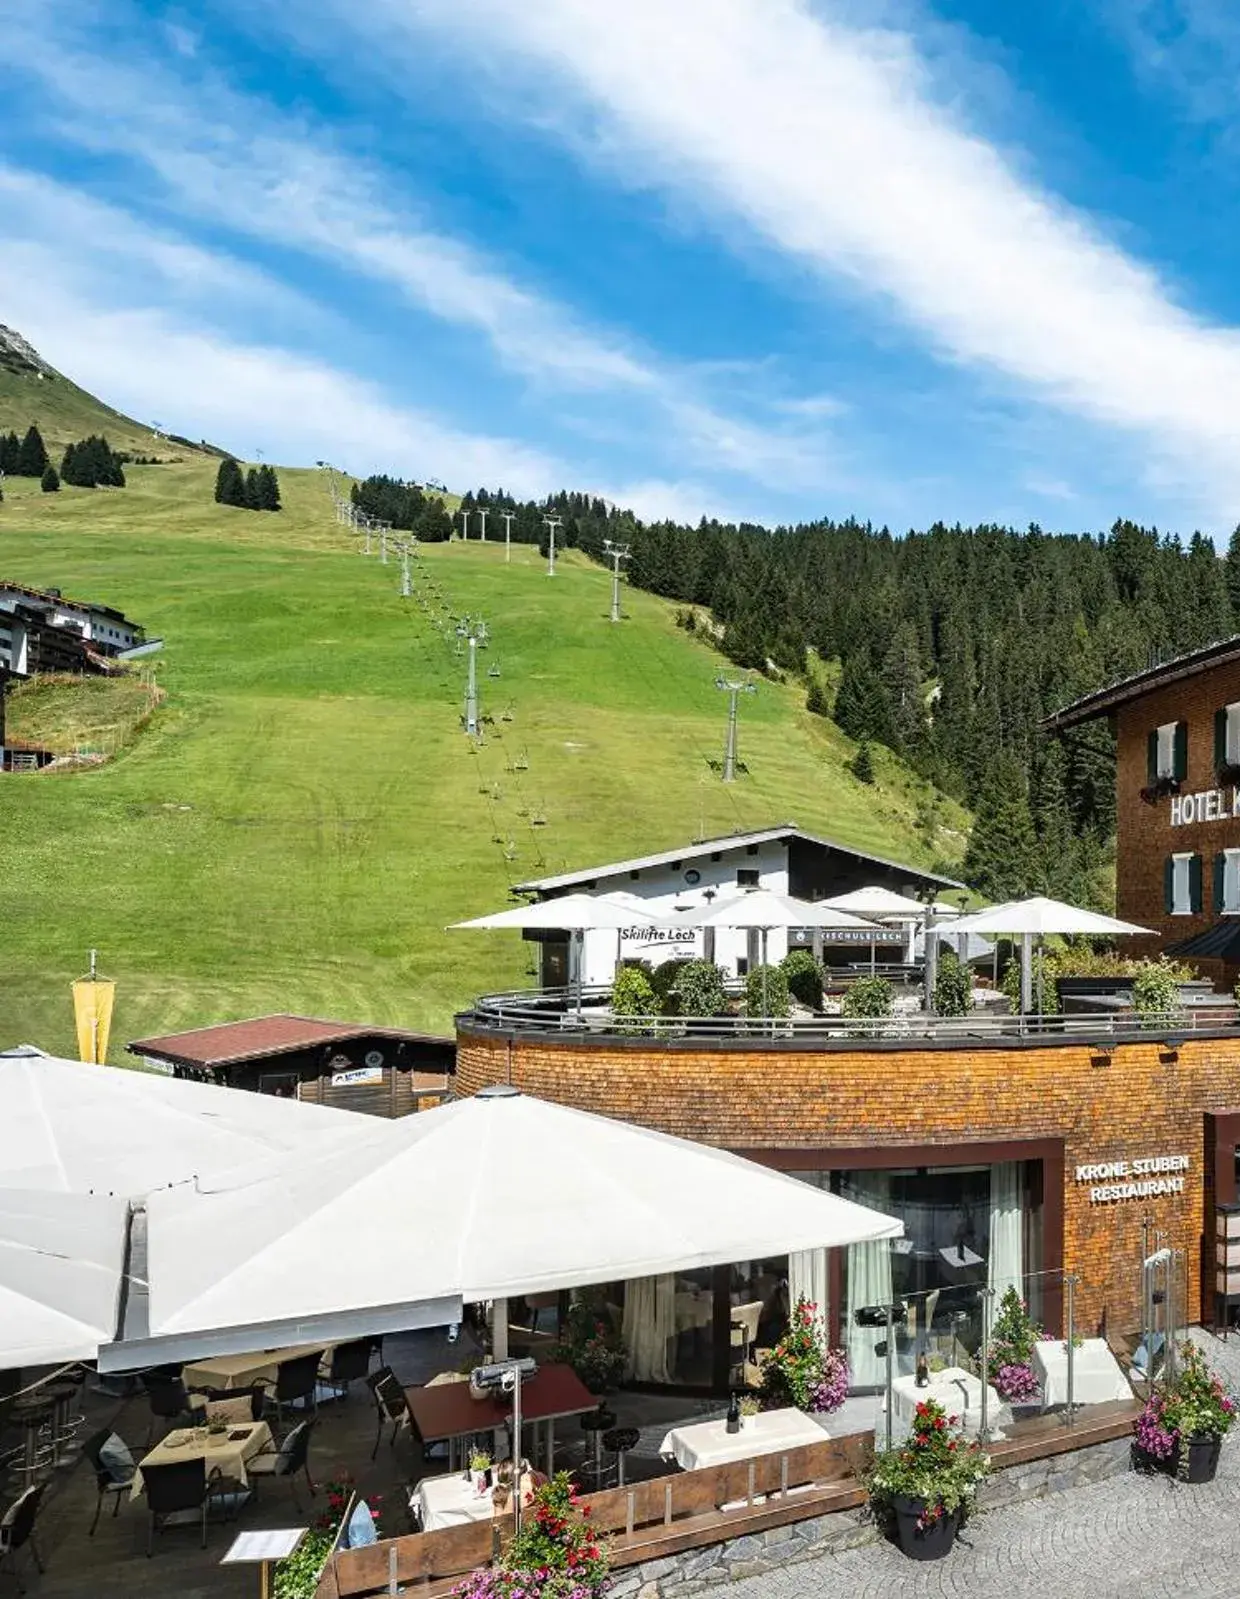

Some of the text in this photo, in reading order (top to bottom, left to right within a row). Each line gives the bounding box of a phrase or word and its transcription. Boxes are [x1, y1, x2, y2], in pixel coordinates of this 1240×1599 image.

[1170, 789, 1227, 826] HOTEL
[621, 926, 695, 942] Skilifte Lech
[876, 932, 902, 941] LECH
[1090, 1177, 1185, 1202] RESTAURANT
